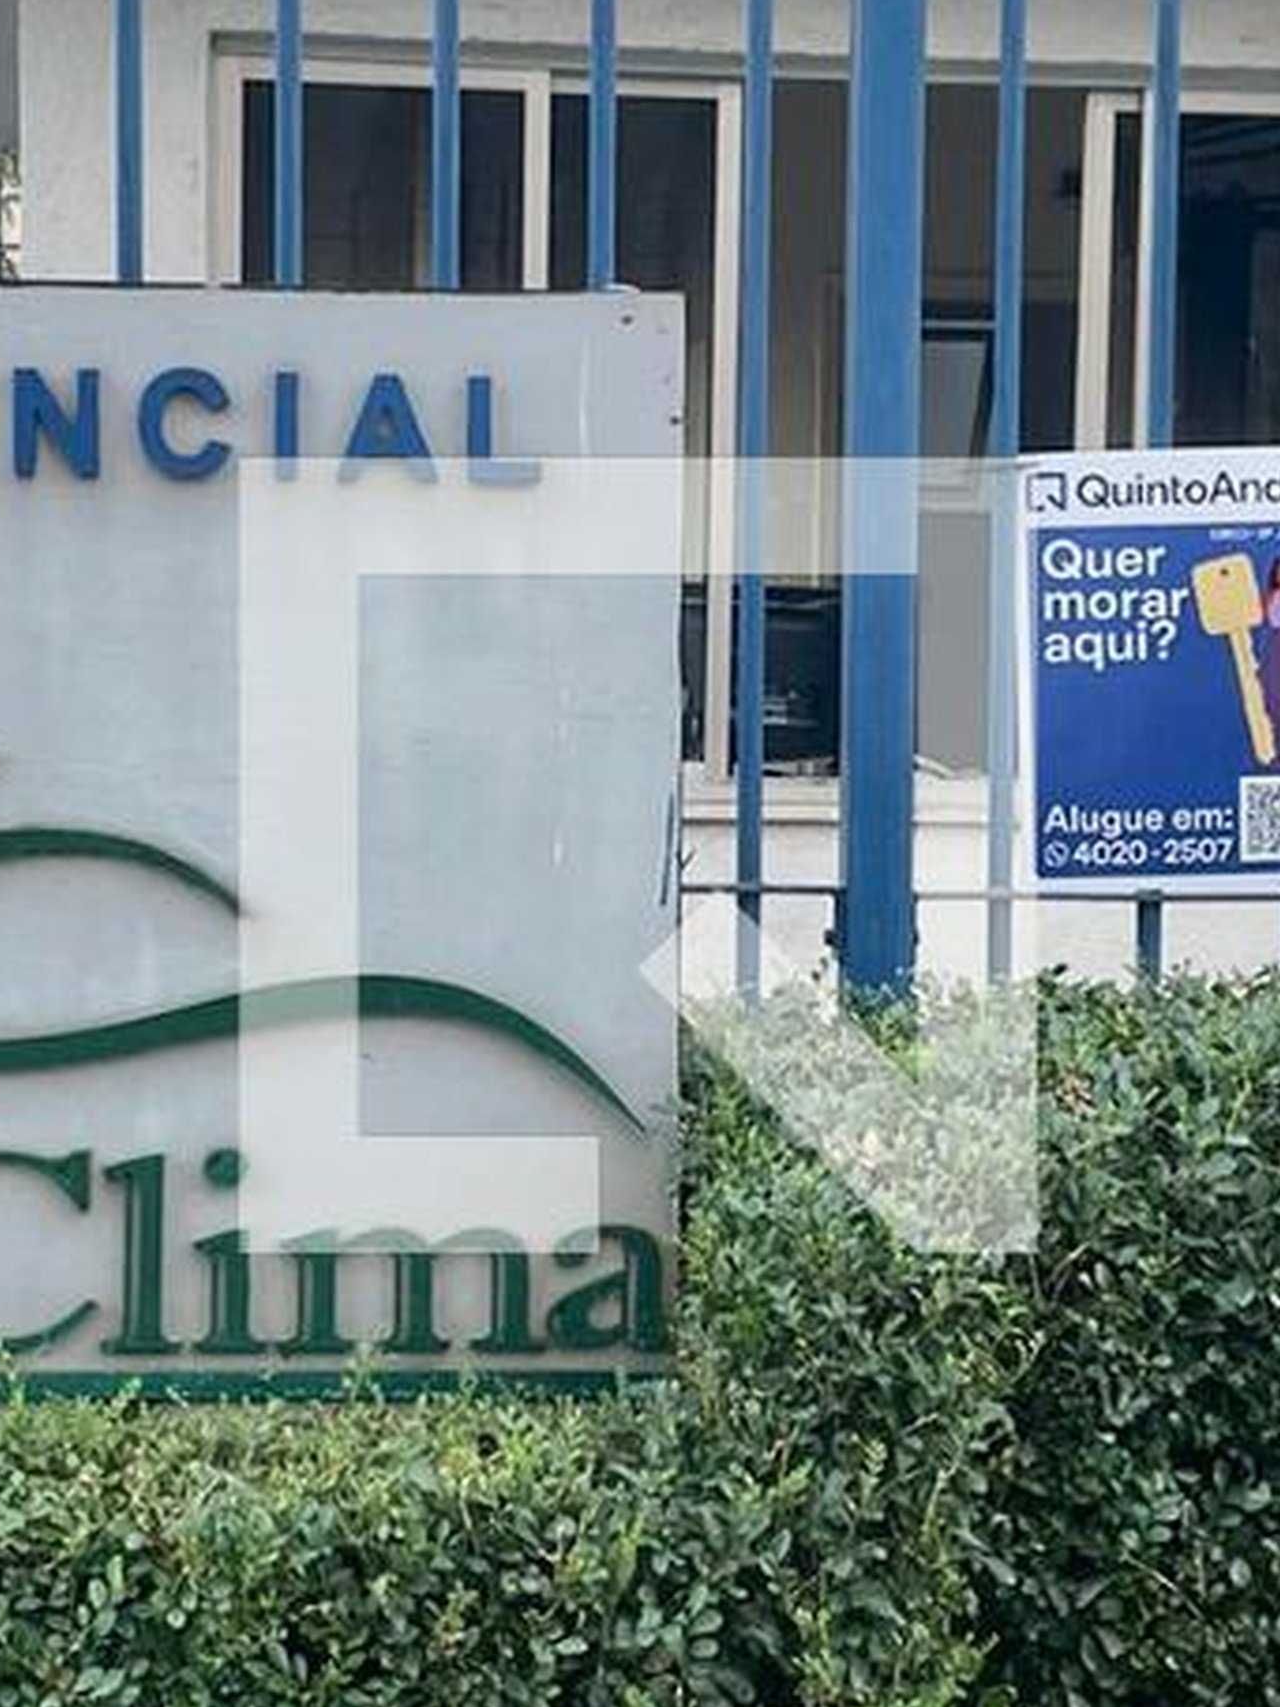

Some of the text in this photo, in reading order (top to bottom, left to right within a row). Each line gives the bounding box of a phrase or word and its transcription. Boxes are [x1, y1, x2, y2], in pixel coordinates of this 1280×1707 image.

[1041, 538, 1166, 580] Quer
[1043, 587, 1190, 620] morar
[1043, 619, 1178, 673] aqui?
[1042, 804, 1234, 840] Alugue em:
